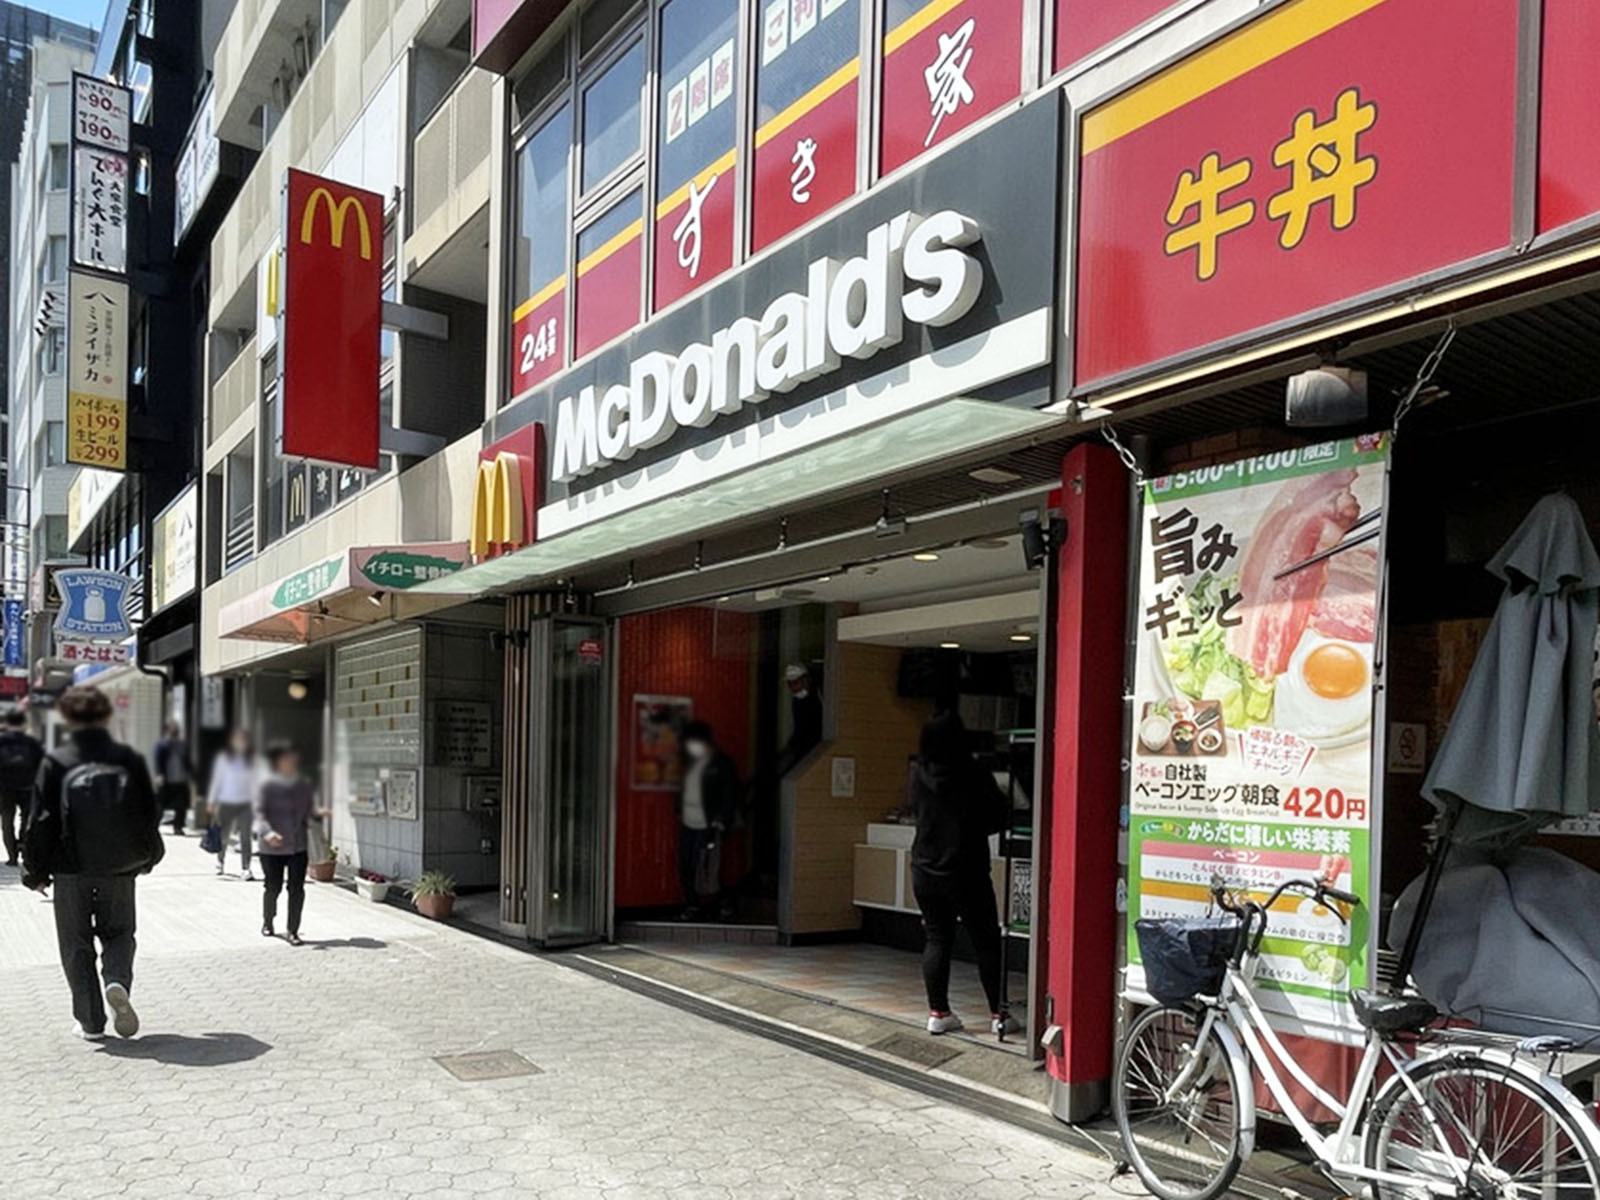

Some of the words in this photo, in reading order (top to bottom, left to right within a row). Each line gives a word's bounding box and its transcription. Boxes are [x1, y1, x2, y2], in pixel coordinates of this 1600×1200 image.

[1163, 87, 1378, 281] 牛丼
[552, 209, 980, 482] McDonald's
[76, 429, 118, 445] 生ビール
[1150, 507, 1239, 584] 旨み
[66, 575, 122, 591] LAWSON
[66, 617, 122, 632] STATION
[1144, 586, 1244, 640] ギュッと
[62, 644, 126, 663] 酒・たばこ
[1165, 763, 1208, 781] 自社製
[1283, 787, 1366, 821] 420円
[1188, 821, 1351, 856] からだに嬉しい栄養素
[1213, 850, 1261, 864] ベーコン
